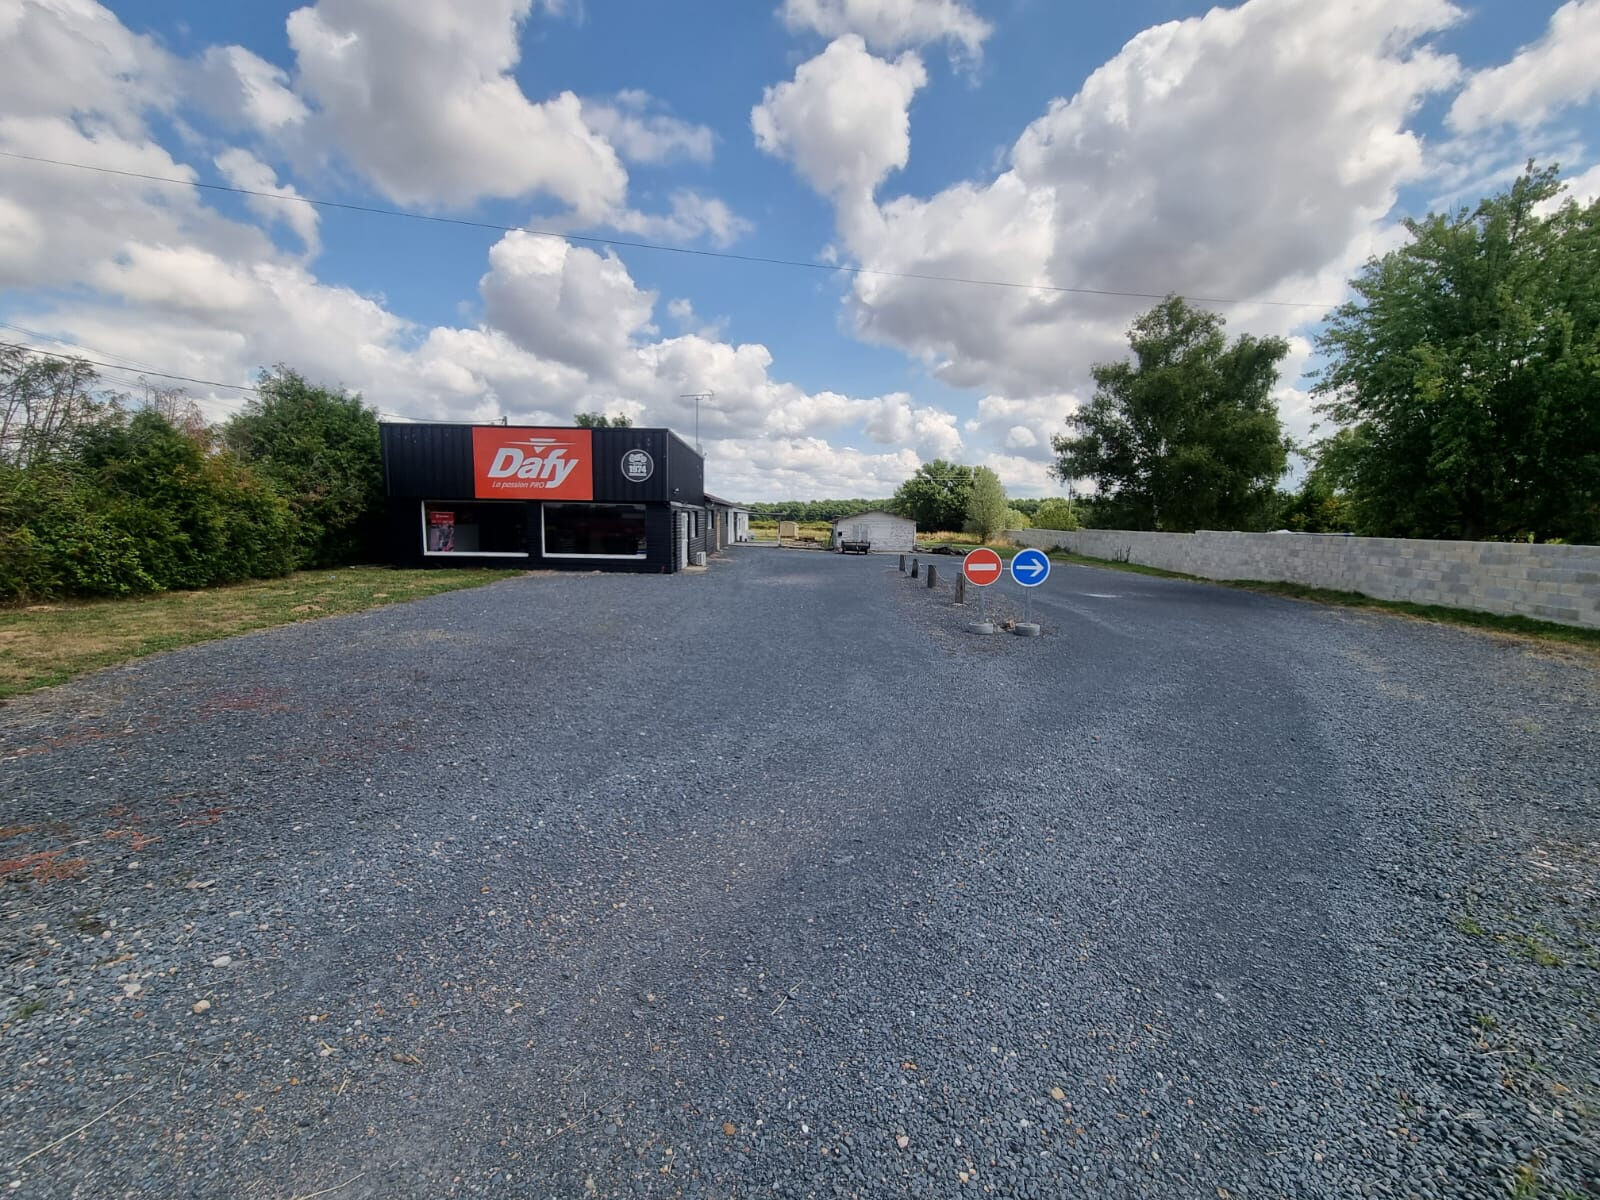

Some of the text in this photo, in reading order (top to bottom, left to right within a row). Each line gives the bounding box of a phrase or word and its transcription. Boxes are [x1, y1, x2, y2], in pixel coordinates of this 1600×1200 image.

[488, 447, 579, 489] Dafy
[501, 481, 529, 490] passion
[529, 481, 545, 489] PRO
